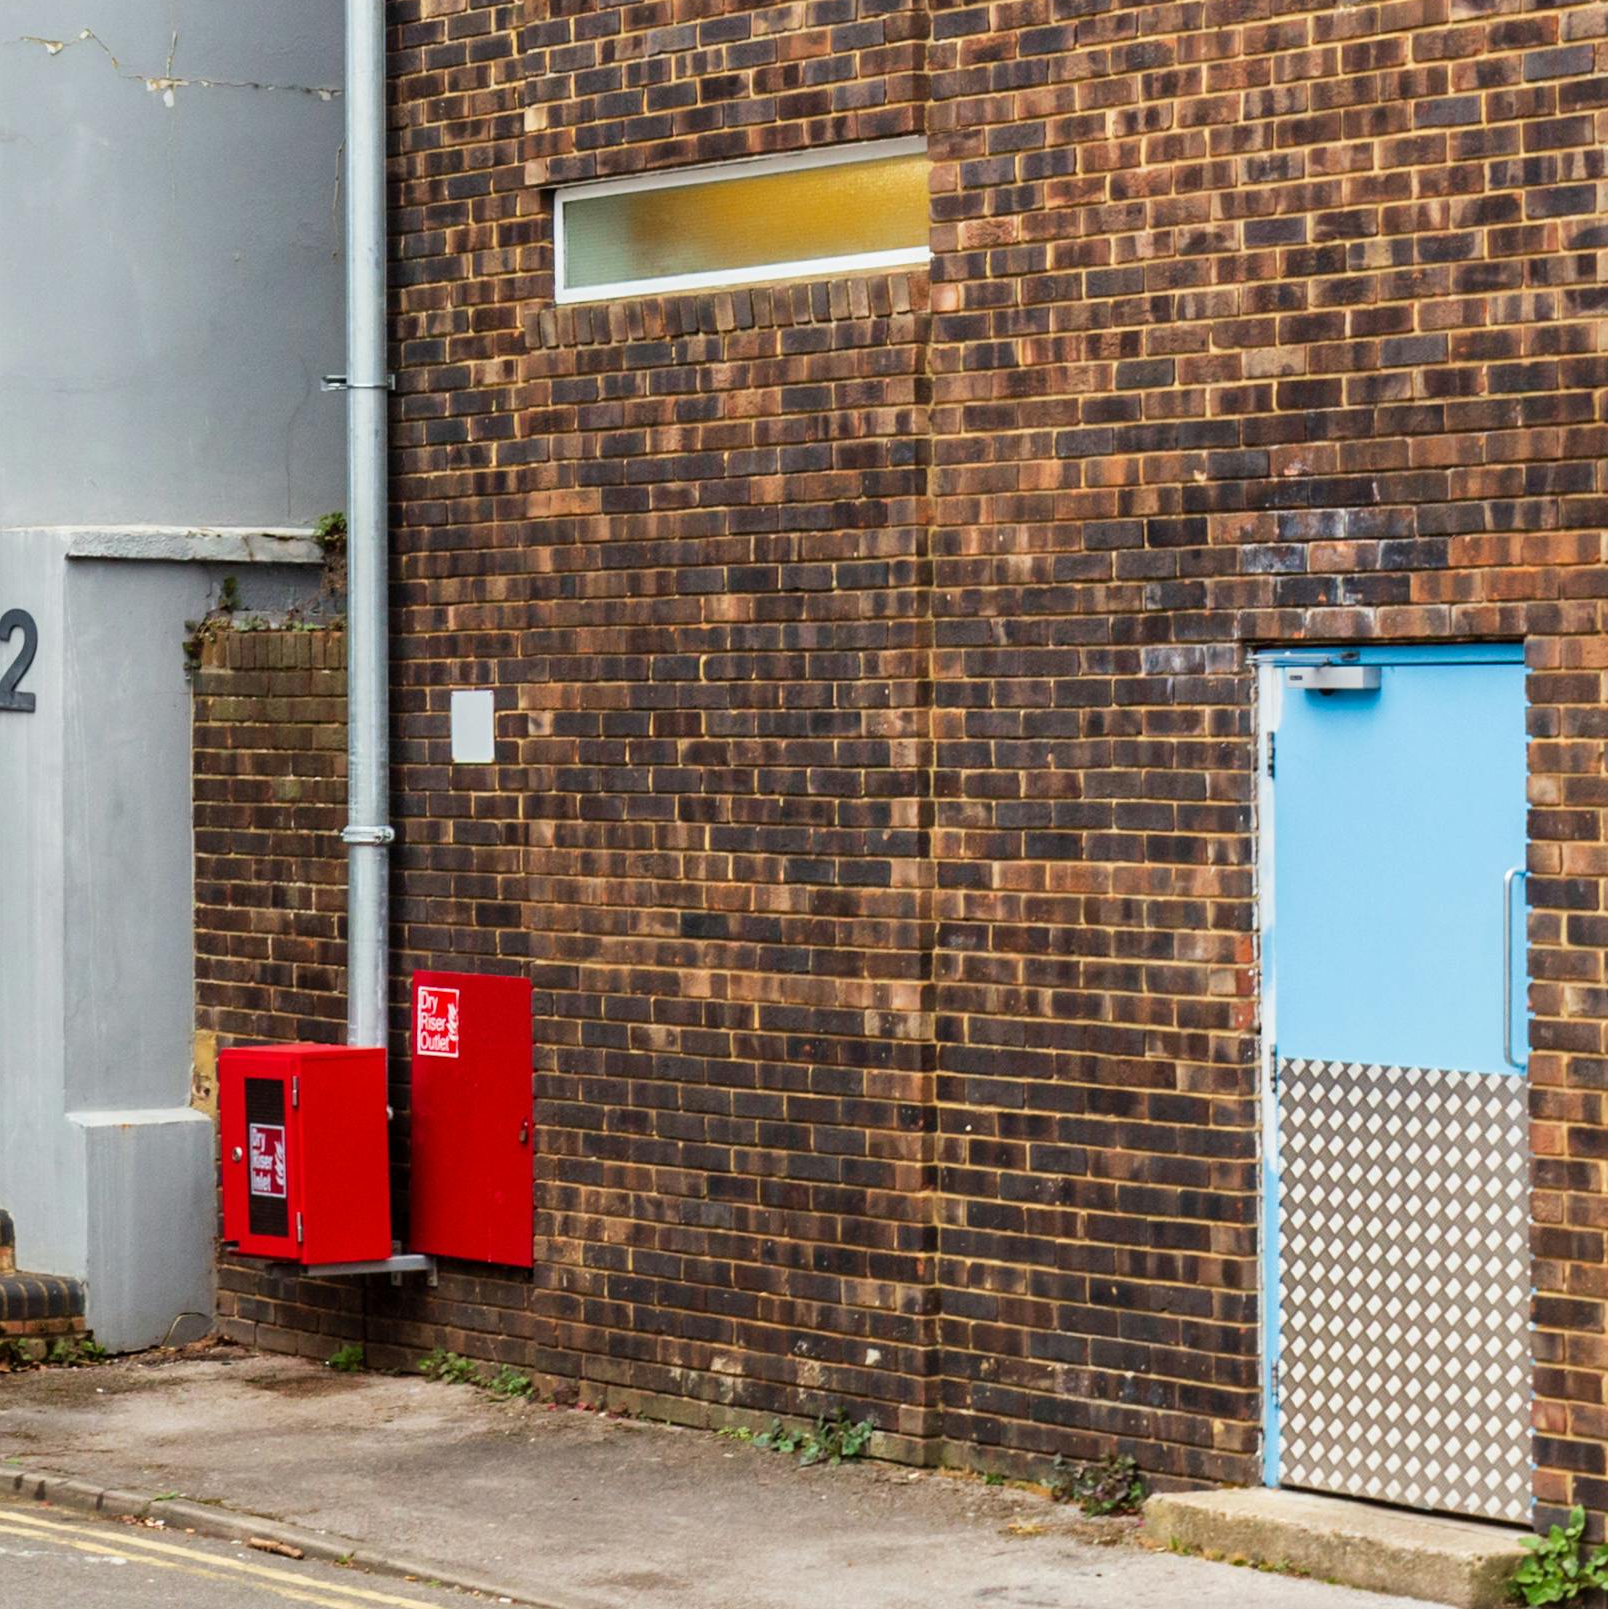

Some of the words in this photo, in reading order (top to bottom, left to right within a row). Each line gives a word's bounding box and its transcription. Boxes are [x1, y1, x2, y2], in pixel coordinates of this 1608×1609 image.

[421, 991, 438, 1015] Dry
[421, 1012, 446, 1031] Riser
[420, 1031, 449, 1051] Outlet
[251, 1127, 266, 1153] Dry
[251, 1150, 273, 1170] Riser
